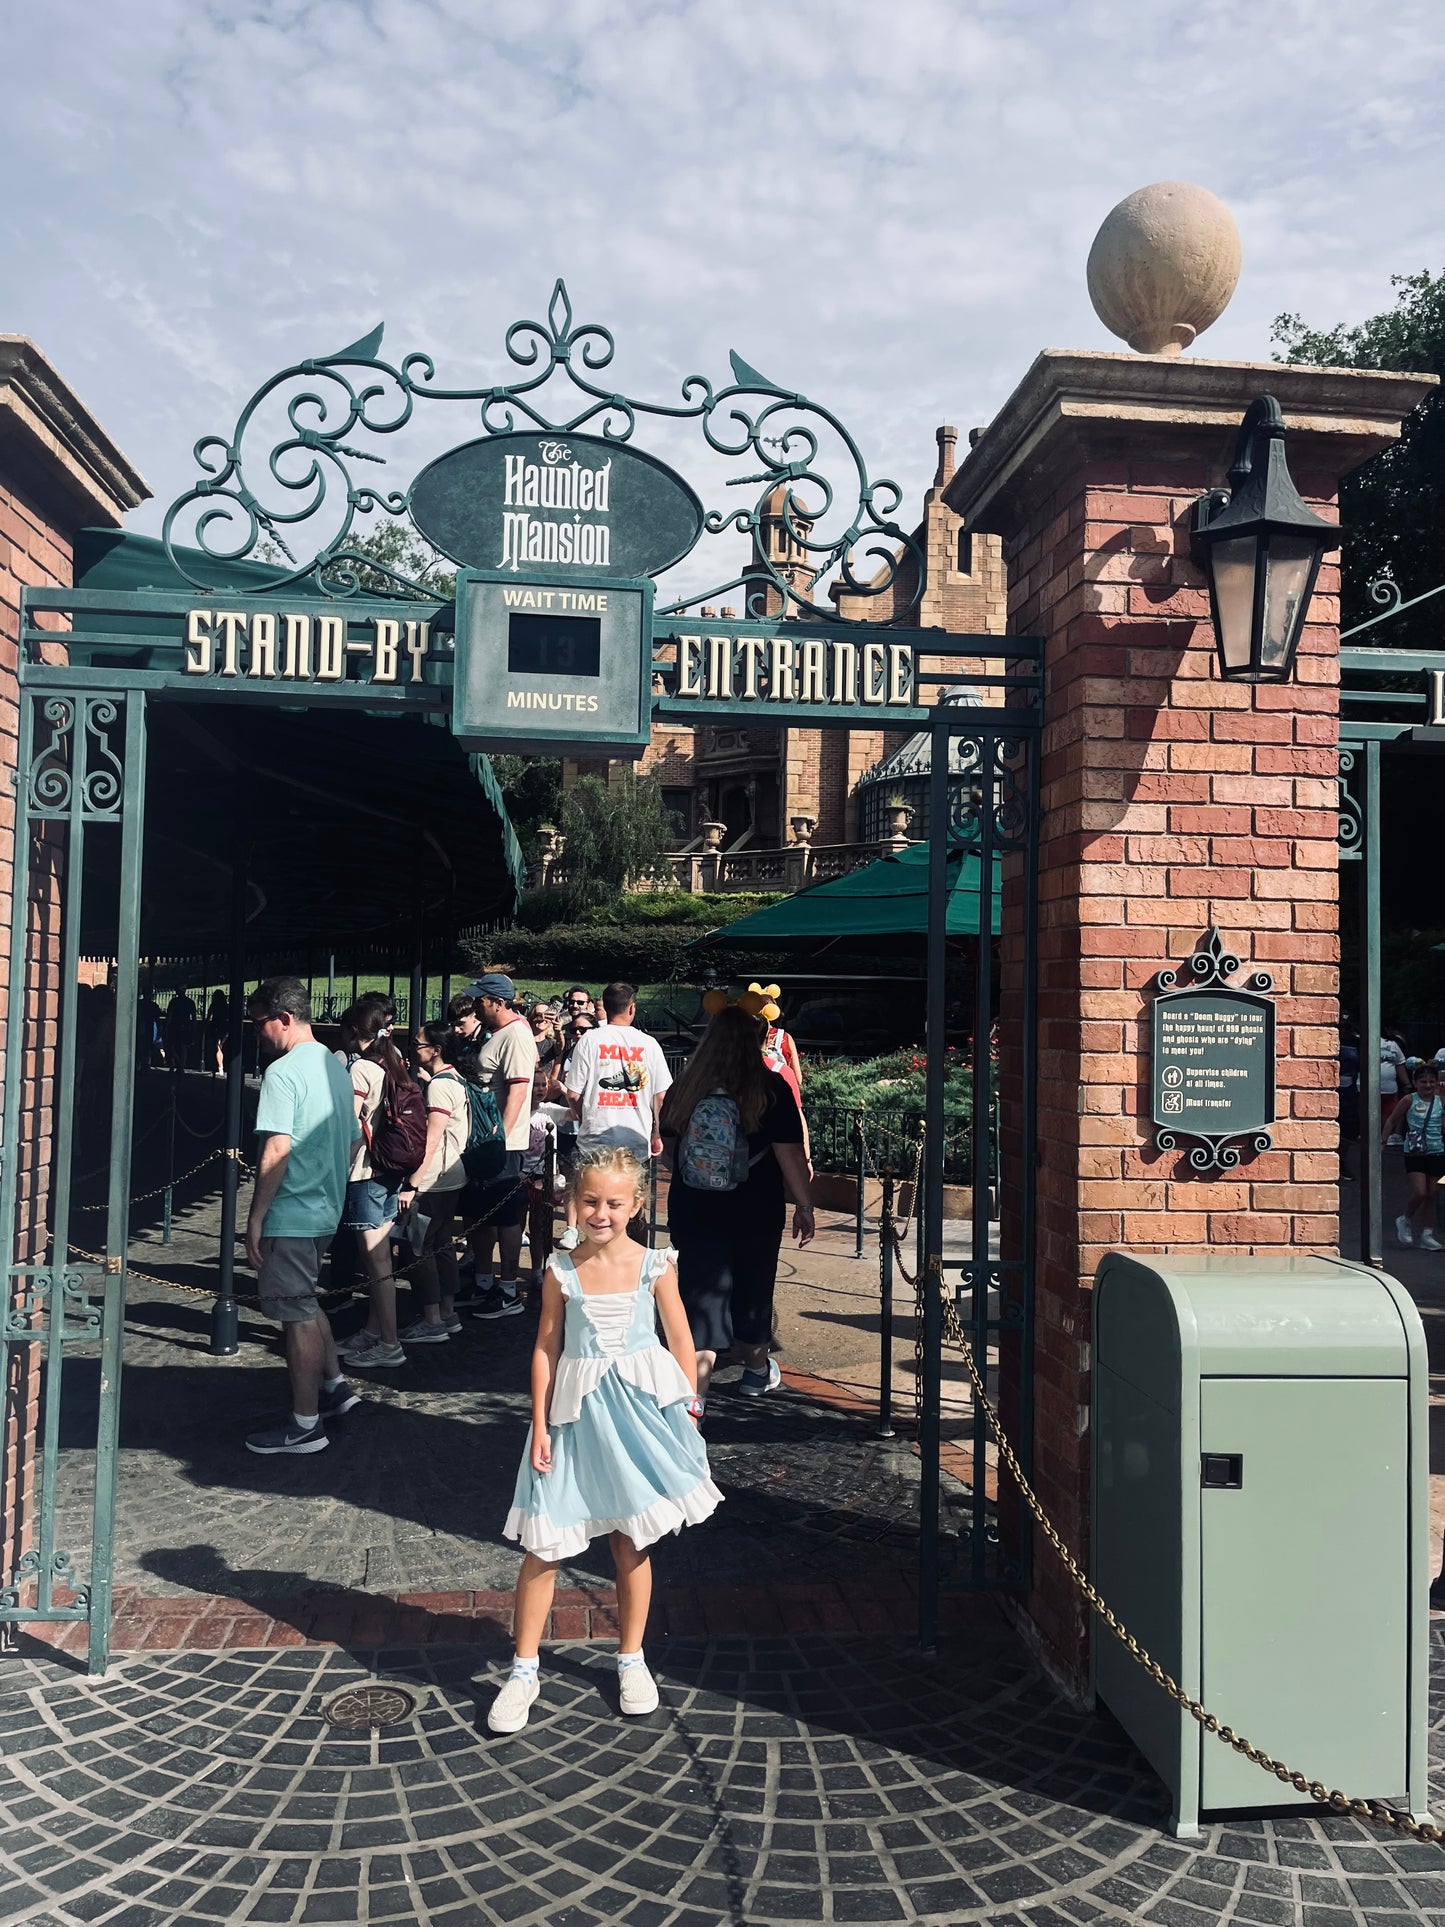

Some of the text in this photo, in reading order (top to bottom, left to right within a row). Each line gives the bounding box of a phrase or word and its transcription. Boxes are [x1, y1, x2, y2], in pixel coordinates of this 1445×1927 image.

[538, 440, 572, 465] The
[503, 454, 612, 512] Haunted
[496, 511, 611, 572] Mansion
[503, 589, 608, 612] WAIT TIME
[186, 609, 431, 683] STAND-BY
[678, 634, 912, 705] ENTRANCE
[506, 691, 599, 712] MINUTES
[1162, 1011, 1183, 1021] Board
[1183, 1013, 1189, 1021] a
[1241, 1014, 1248, 1022] to
[1249, 1014, 1264, 1022] tour
[1162, 1023, 1264, 1034] the happy haunt of 999 ghouls
[1162, 1035, 1175, 1044] and
[1176, 1035, 1199, 1045] ghosts
[1200, 1035, 1216, 1045] who
[1217, 1036, 1229, 1045] are
[599, 1044, 644, 1062] MAX
[1162, 1046, 1205, 1056] to meet you!
[1186, 1067, 1248, 1078] Supervise children
[1186, 1079, 1226, 1089] at all times.
[598, 1092, 638, 1106] HEAT
[1186, 1098, 1232, 1108] Must transfer
